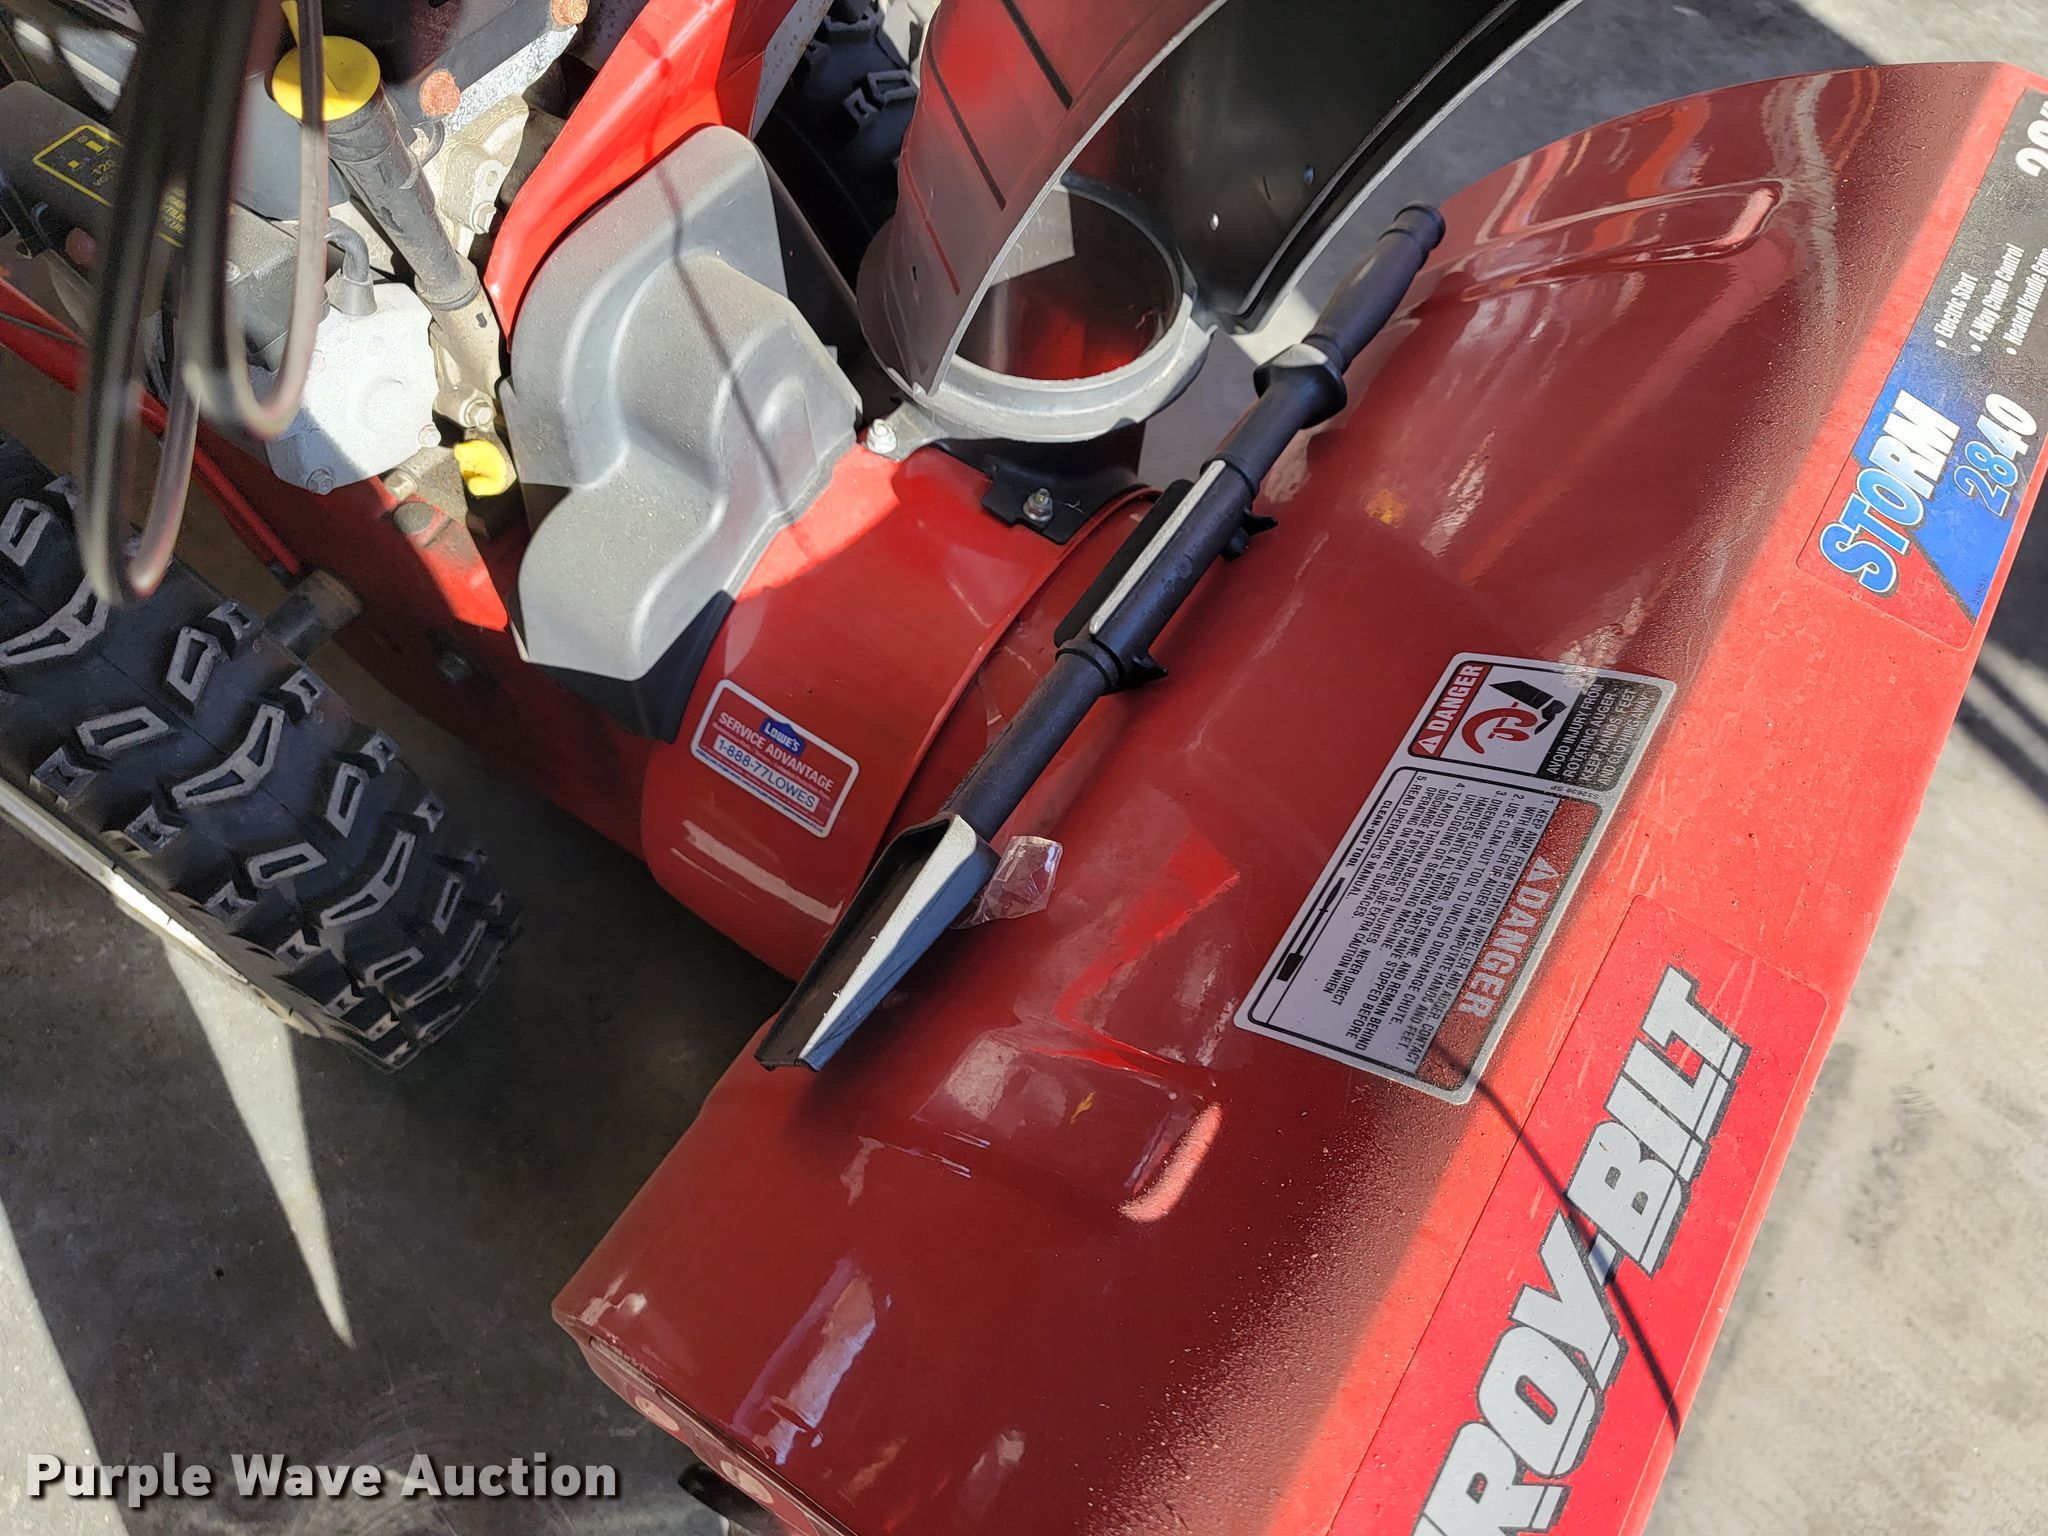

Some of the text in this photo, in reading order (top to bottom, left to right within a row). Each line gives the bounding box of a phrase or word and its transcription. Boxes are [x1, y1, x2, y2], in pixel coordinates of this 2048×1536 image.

[1933, 271, 1979, 339] Electric Start
[1968, 242, 2025, 343] 4-Way Chute Control
[2002, 306, 2034, 346] Heated
[2017, 273, 2047, 311] Handle
[1953, 392, 2037, 518] 2840
[1819, 389, 1961, 597] STORM
[1426, 663, 1484, 732] DANGER
[1544, 682, 1605, 774] AVOID INJURY FROM
[716, 710, 767, 750] SERVICE
[764, 740, 835, 793] ADVANTAGE
[762, 720, 802, 753] LOWE'S
[1560, 727, 1600, 778] ROTATING
[1588, 692, 1618, 727] AUGER
[1578, 752, 1605, 781] KEEP
[1613, 688, 1638, 713] FEET
[715, 737, 817, 809] 1-888-77LOWES
[1539, 798, 1555, 807] 1.
[1344, 799, 1393, 869] CLEAN-OUT TOOL
[1344, 774, 1428, 901] 5. READ OPERATOR'S MANUAL.
[1495, 826, 1526, 864] IMPELLER
[1515, 805, 1537, 826] WITH
[1515, 829, 1538, 854] AWAY
[1528, 807, 1550, 829] KEEP
[1350, 785, 1438, 921] OPERATING ON GRAVEL SURFACES.
[1377, 793, 1478, 953] UNCLOGGING OR SERVICING MACHINE.
[1488, 864, 1505, 877] OR
[1501, 854, 1525, 880] FROM
[1321, 788, 1450, 994] DISCHARGE AT BYSTANDERS. USE EXTRA CAUTION WHEN
[1329, 781, 1467, 1006] 4. TO AVOID THROWN OBJECTS INJURIES, NEVER DIRECT
[1344, 795, 1490, 1040] HANDLES UNTIL ALL MOVING PARTS HAVE STOPPED BEFORE
[1353, 789, 1508, 1051] 3. DISENGAGE CLUTCH LEVERS, STOP ENGINE, AND REMAIN BEHIND
[1387, 792, 1525, 1028] 2. USE CLEAN-OUT TOOL TO UNCLOG DISCHARGE CHUTE.
[1462, 906, 1483, 926] CAN
[1472, 877, 1499, 907] AUGER
[1477, 880, 1511, 924] ROTATING
[1437, 925, 1473, 972] AMPUTATE
[1443, 969, 1464, 990] AND
[1453, 924, 1488, 970] IMPELLER
[1455, 885, 1550, 1020] DANGER
[1394, 1024, 1419, 1052] FEET.
[1403, 1022, 1436, 1066] CONTACT
[1409, 1003, 1430, 1025] AND
[1411, 965, 1750, 1536] ROY-BILT
